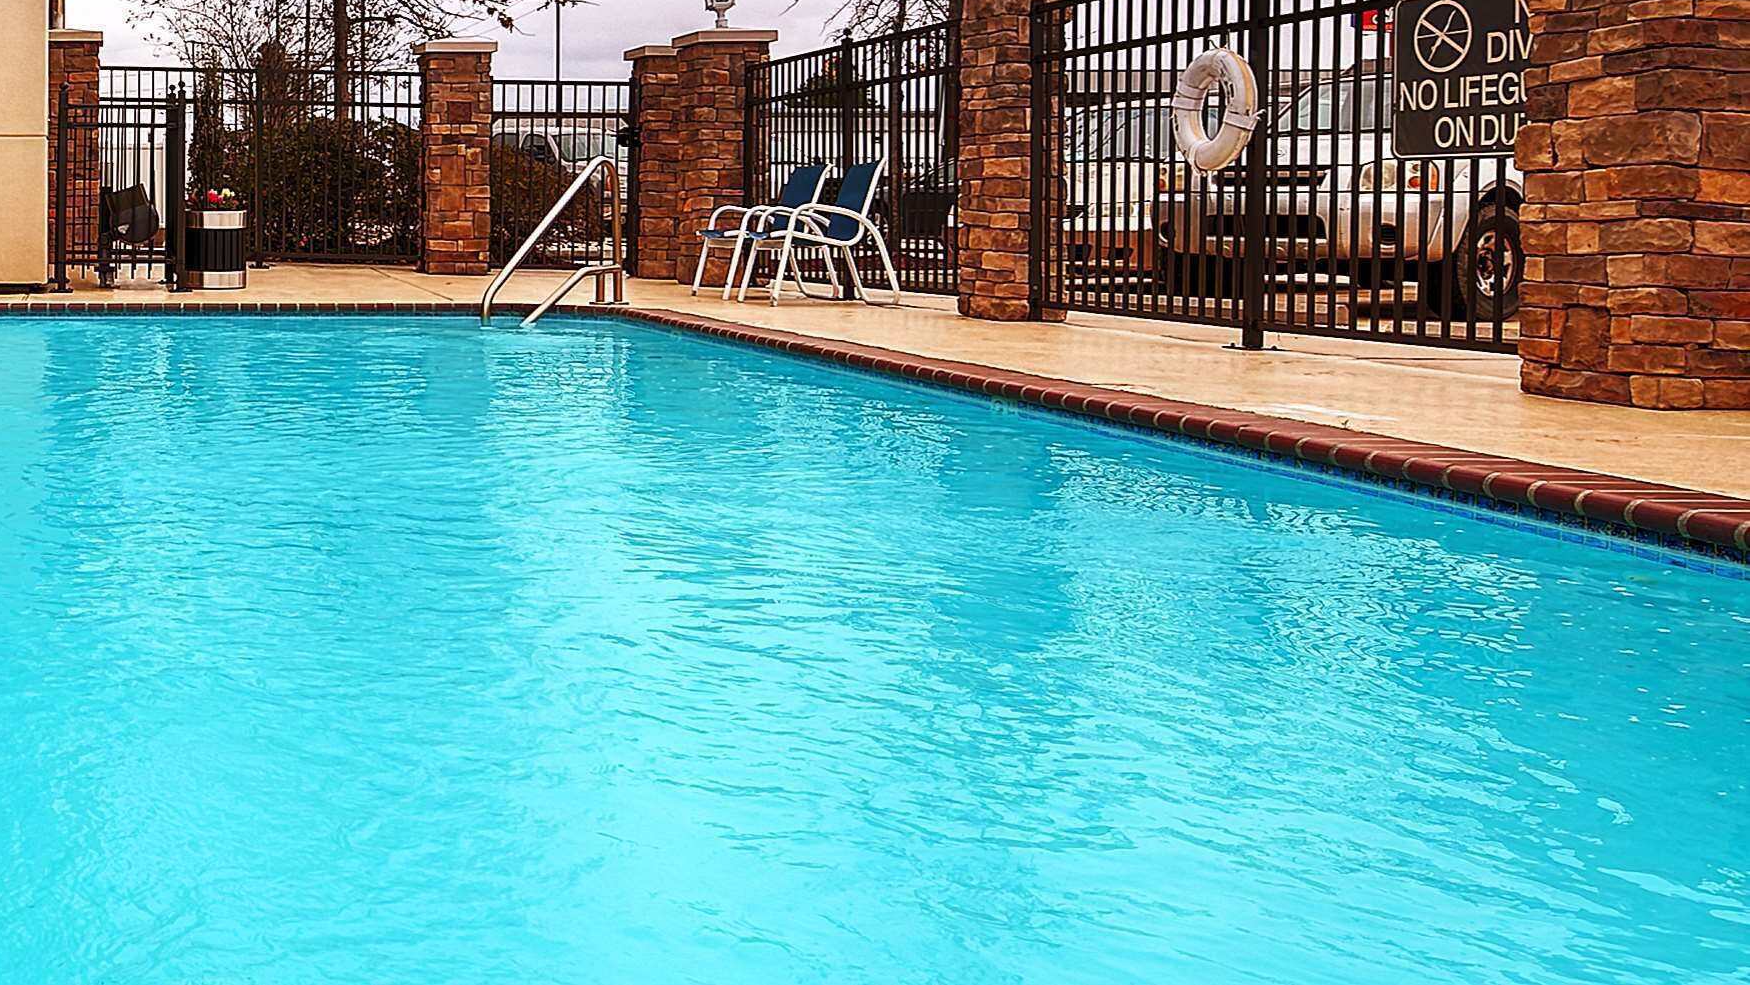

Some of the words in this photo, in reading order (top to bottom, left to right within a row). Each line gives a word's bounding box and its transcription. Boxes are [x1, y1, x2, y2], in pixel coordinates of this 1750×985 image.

[1486, 28, 1534, 64] DIV
[1399, 78, 1439, 112] NO
[1444, 71, 1529, 109] LIFEG
[1434, 115, 1475, 149] ON
[1479, 112, 1530, 147] DU
